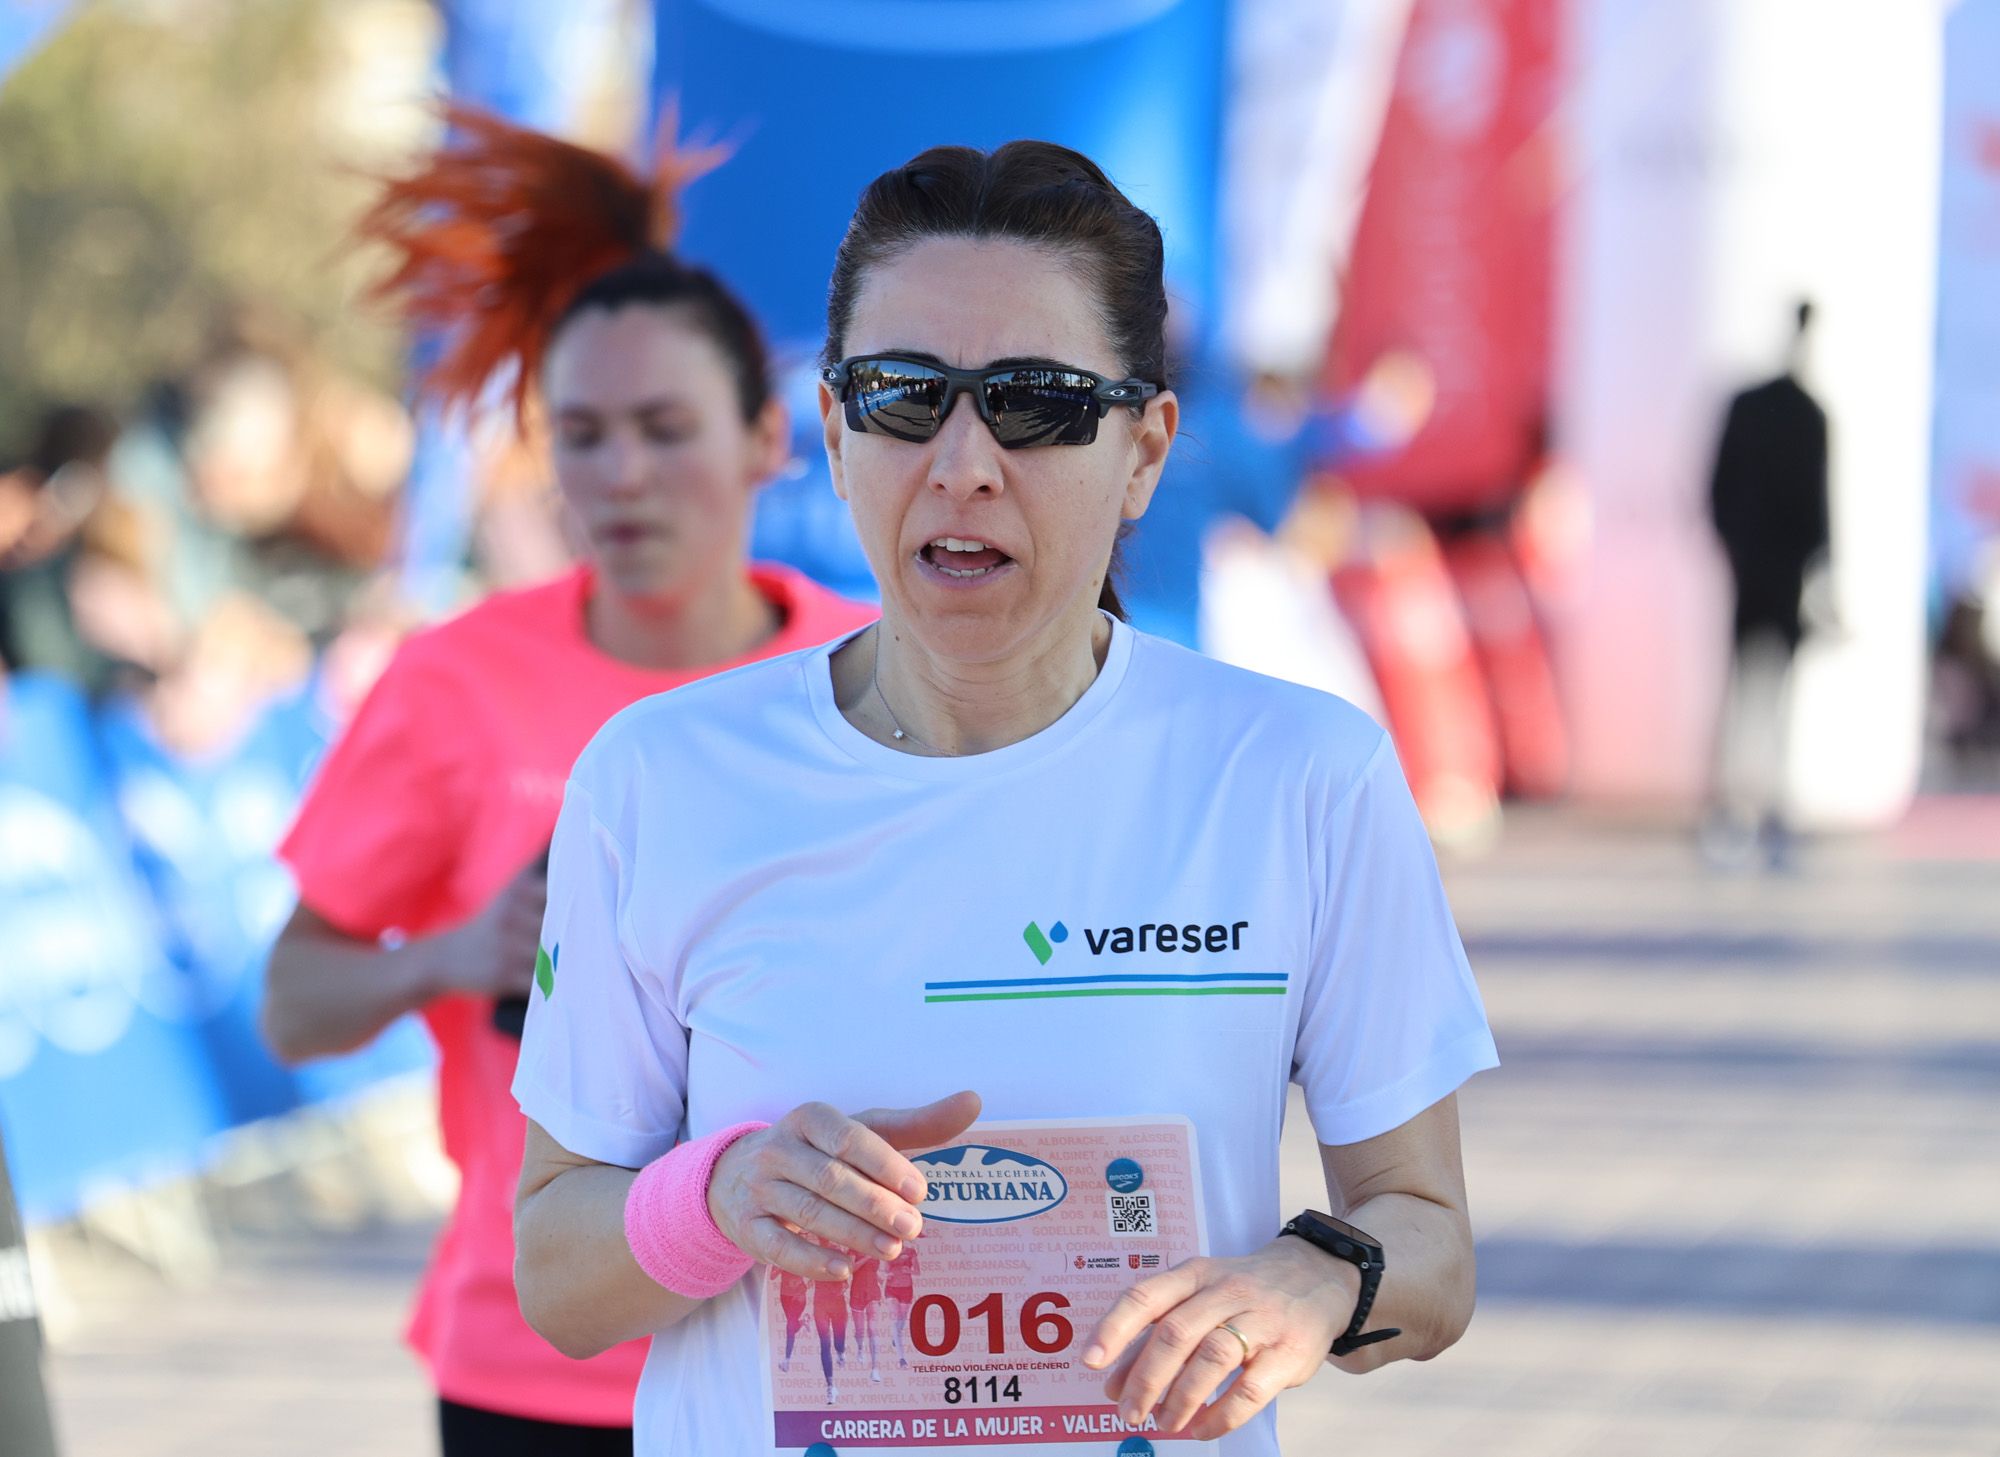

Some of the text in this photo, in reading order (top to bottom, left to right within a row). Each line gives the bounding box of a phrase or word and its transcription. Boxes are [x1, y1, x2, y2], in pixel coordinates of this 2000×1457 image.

[1084, 921, 1248, 955] vareser
[925, 1168, 1047, 1179] CENTRAL LECHERA
[1109, 1172, 1139, 1181] BROOKS
[922, 1180, 1056, 1202] STURIANA
[1029, 1242, 1044, 1253] DE
[1047, 1241, 1063, 1252] LA
[910, 1291, 1074, 1357] 016
[912, 1363, 962, 1374] TELÉFONO
[963, 1361, 1014, 1373] VIOLENCIA
[1015, 1361, 1029, 1371] DE
[944, 1375, 1022, 1404] 8114
[820, 1418, 906, 1440] CARRERA
[912, 1418, 938, 1438] DE
[943, 1417, 969, 1437] LA
[975, 1415, 1043, 1437] MUJER
